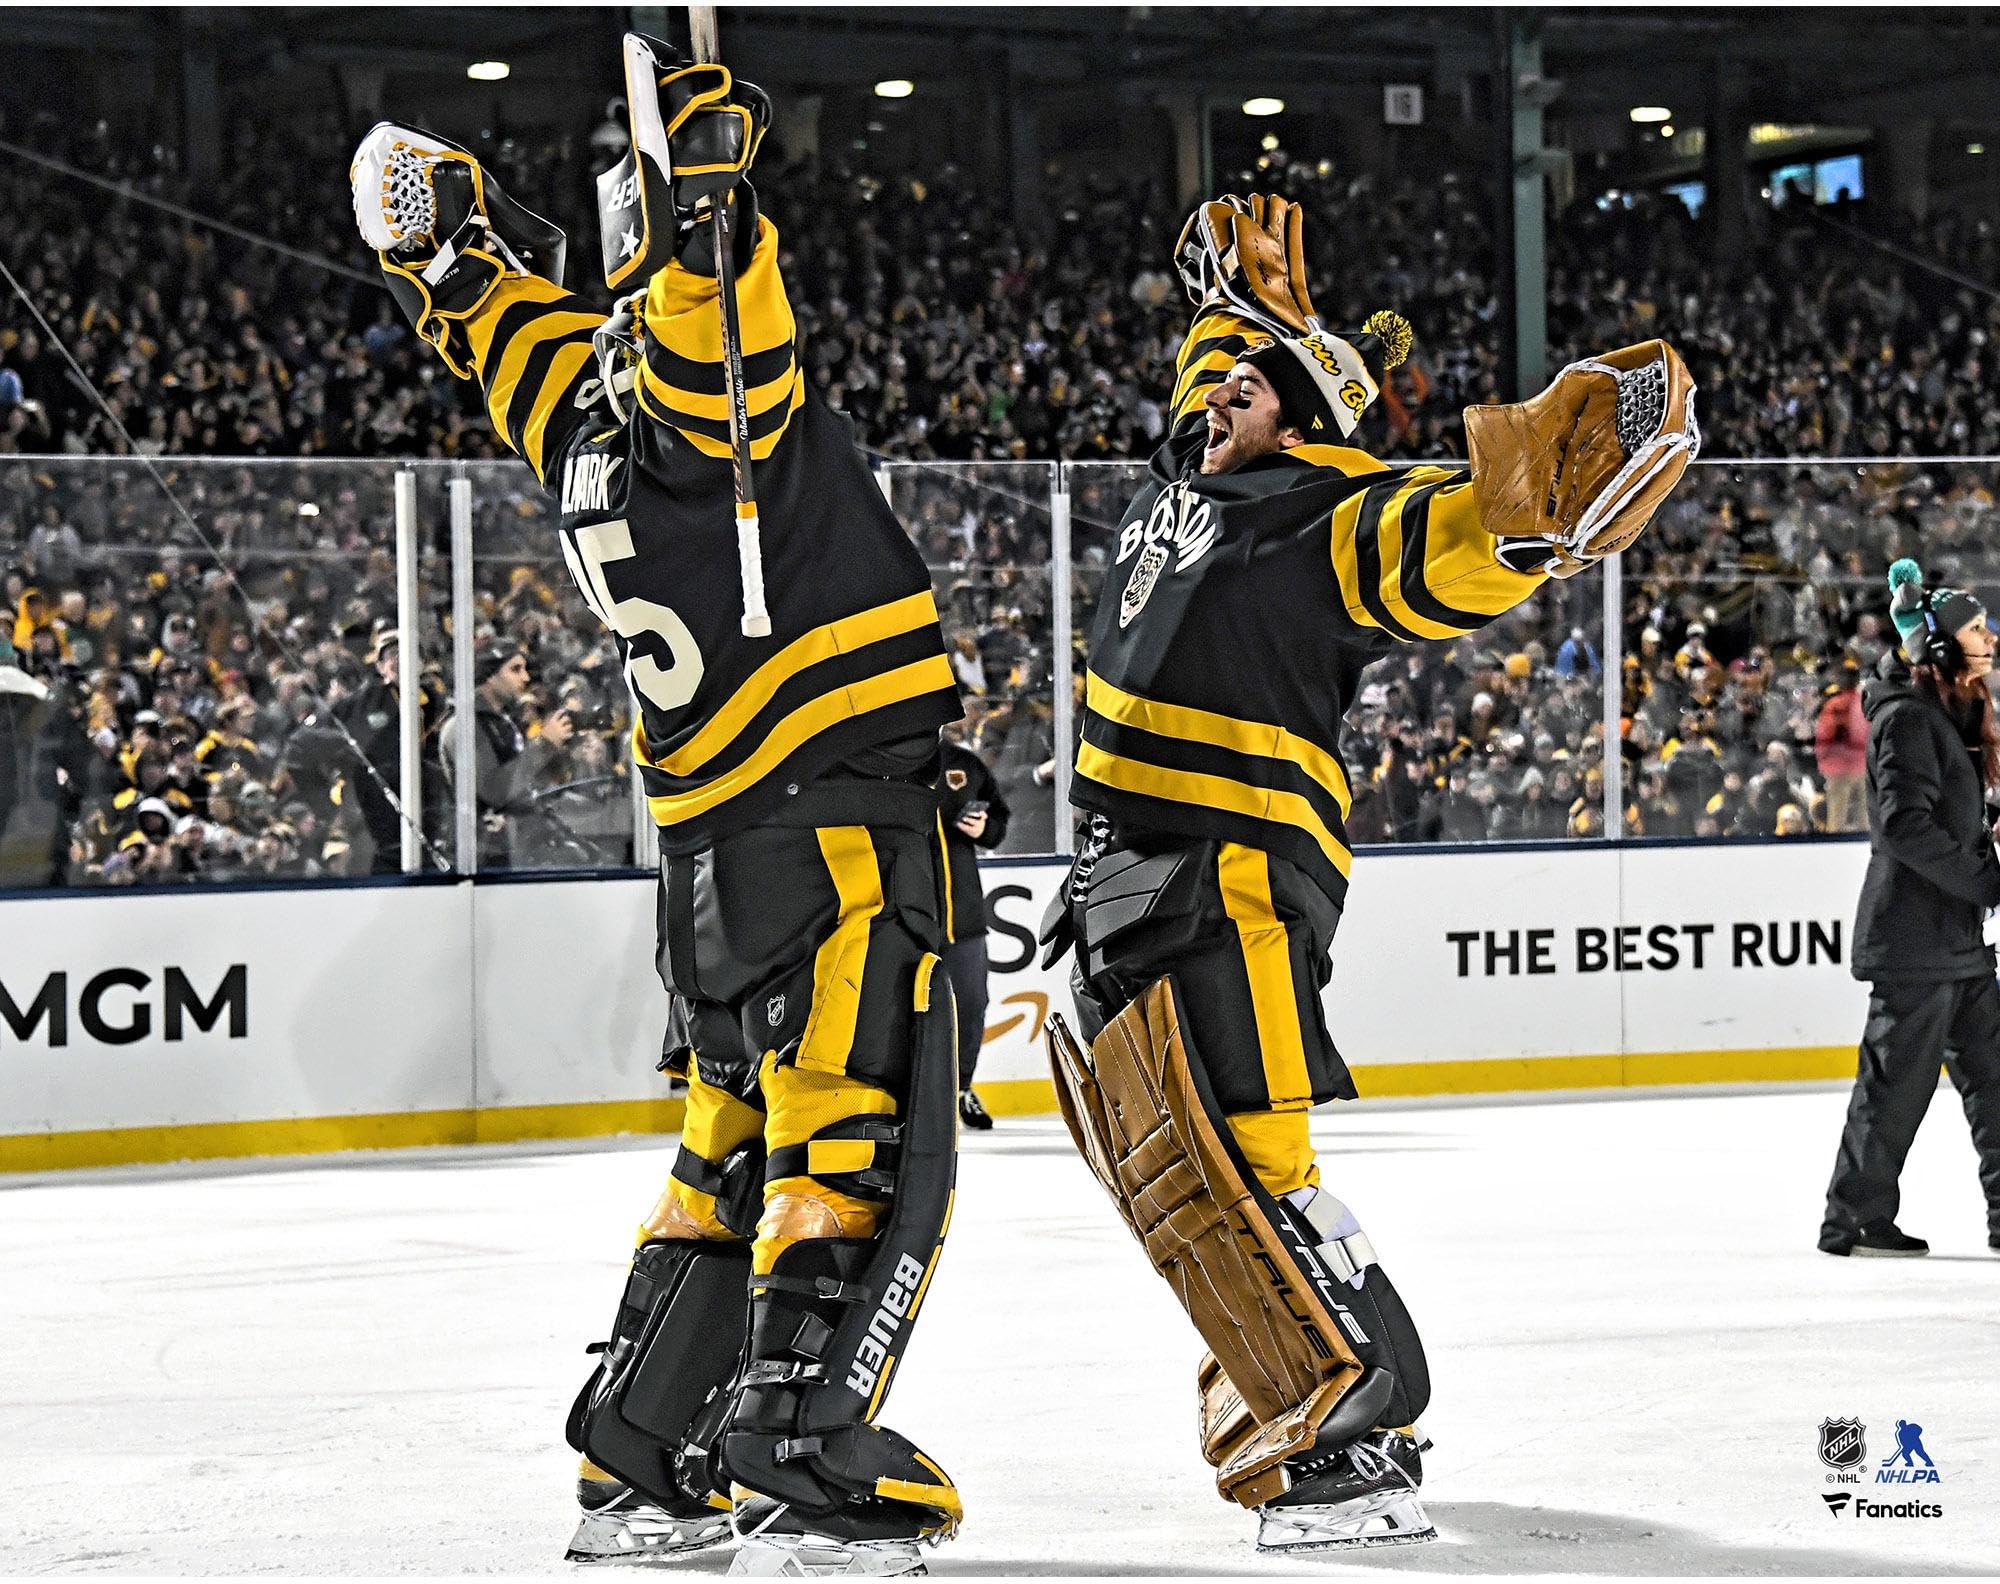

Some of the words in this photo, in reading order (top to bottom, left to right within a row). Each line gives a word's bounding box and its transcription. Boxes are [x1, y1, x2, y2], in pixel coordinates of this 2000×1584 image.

[1115, 486, 1217, 574] BOSTON
[0, 963, 248, 1048] MGM
[1446, 928, 1557, 978] THE
[1576, 923, 1715, 974] BEST
[1732, 920, 1842, 968] RUN
[845, 1252, 925, 1398] BAUER
[1236, 1209, 1335, 1359] TRUE
[1277, 1206, 1371, 1344] TRUE
